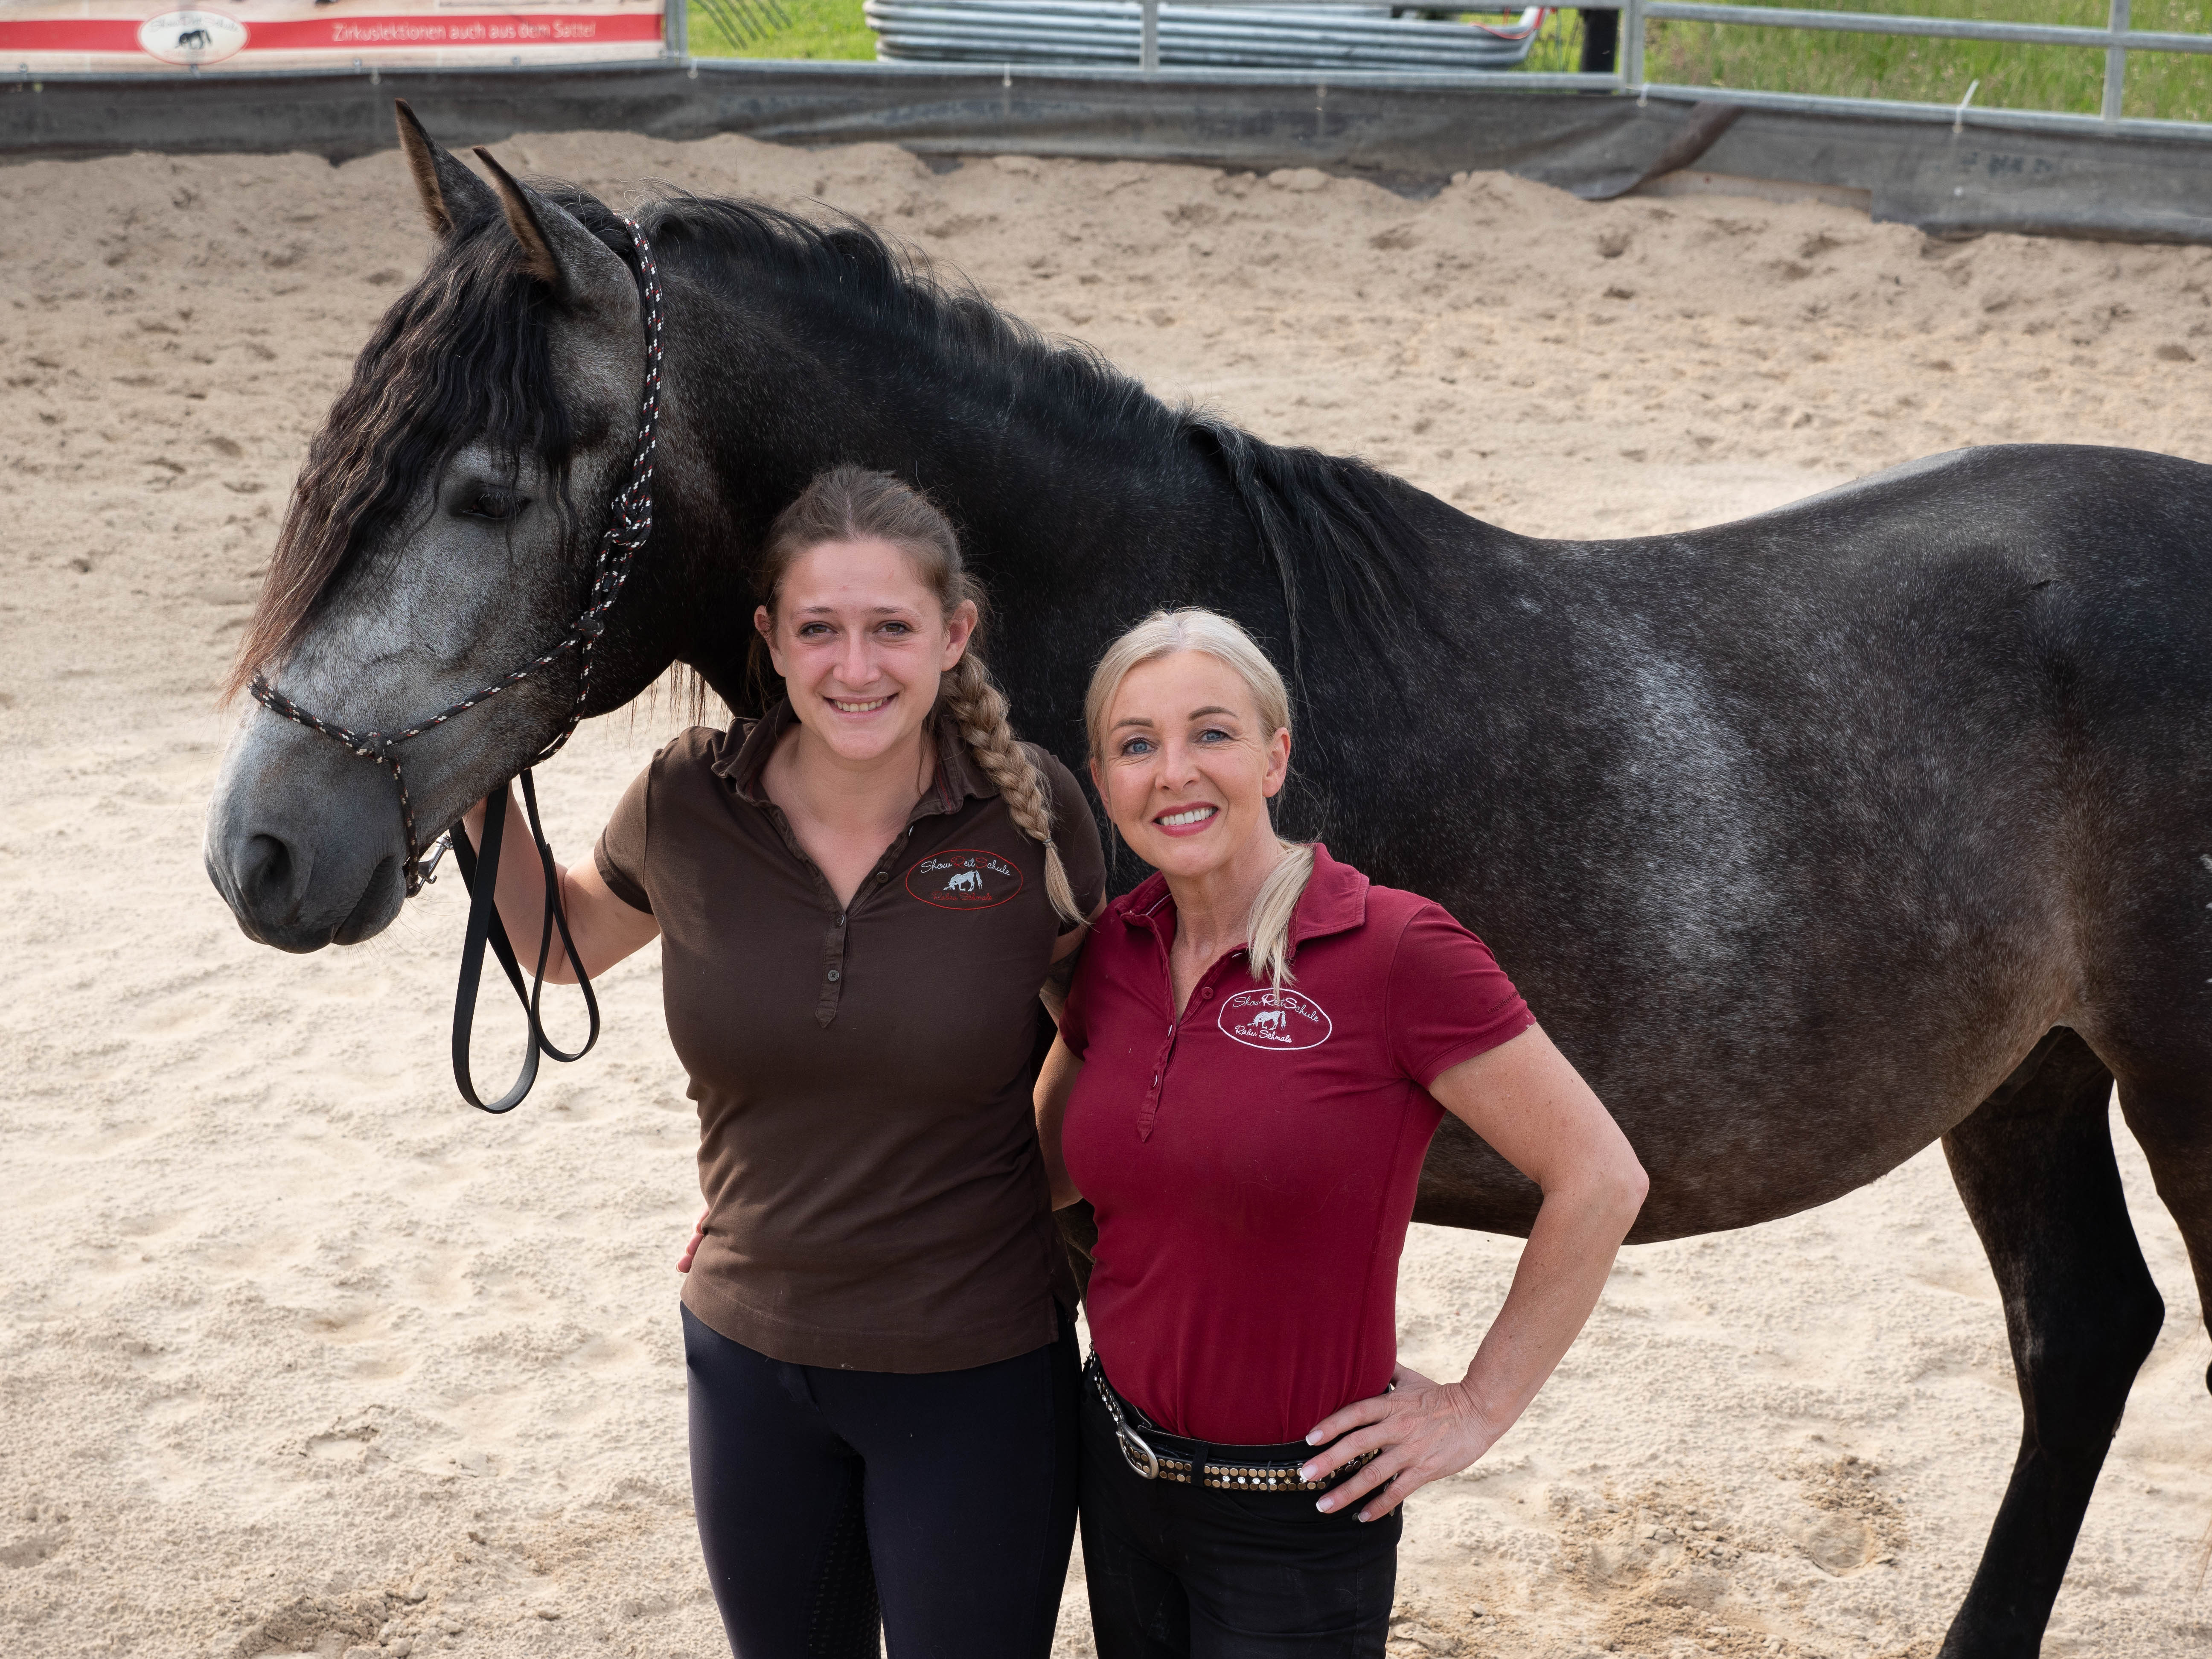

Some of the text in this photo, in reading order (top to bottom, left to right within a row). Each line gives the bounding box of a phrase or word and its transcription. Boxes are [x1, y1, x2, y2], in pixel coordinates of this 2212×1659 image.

[333, 21, 596, 41] Zirkuslektionen auch aus dem Sattel
